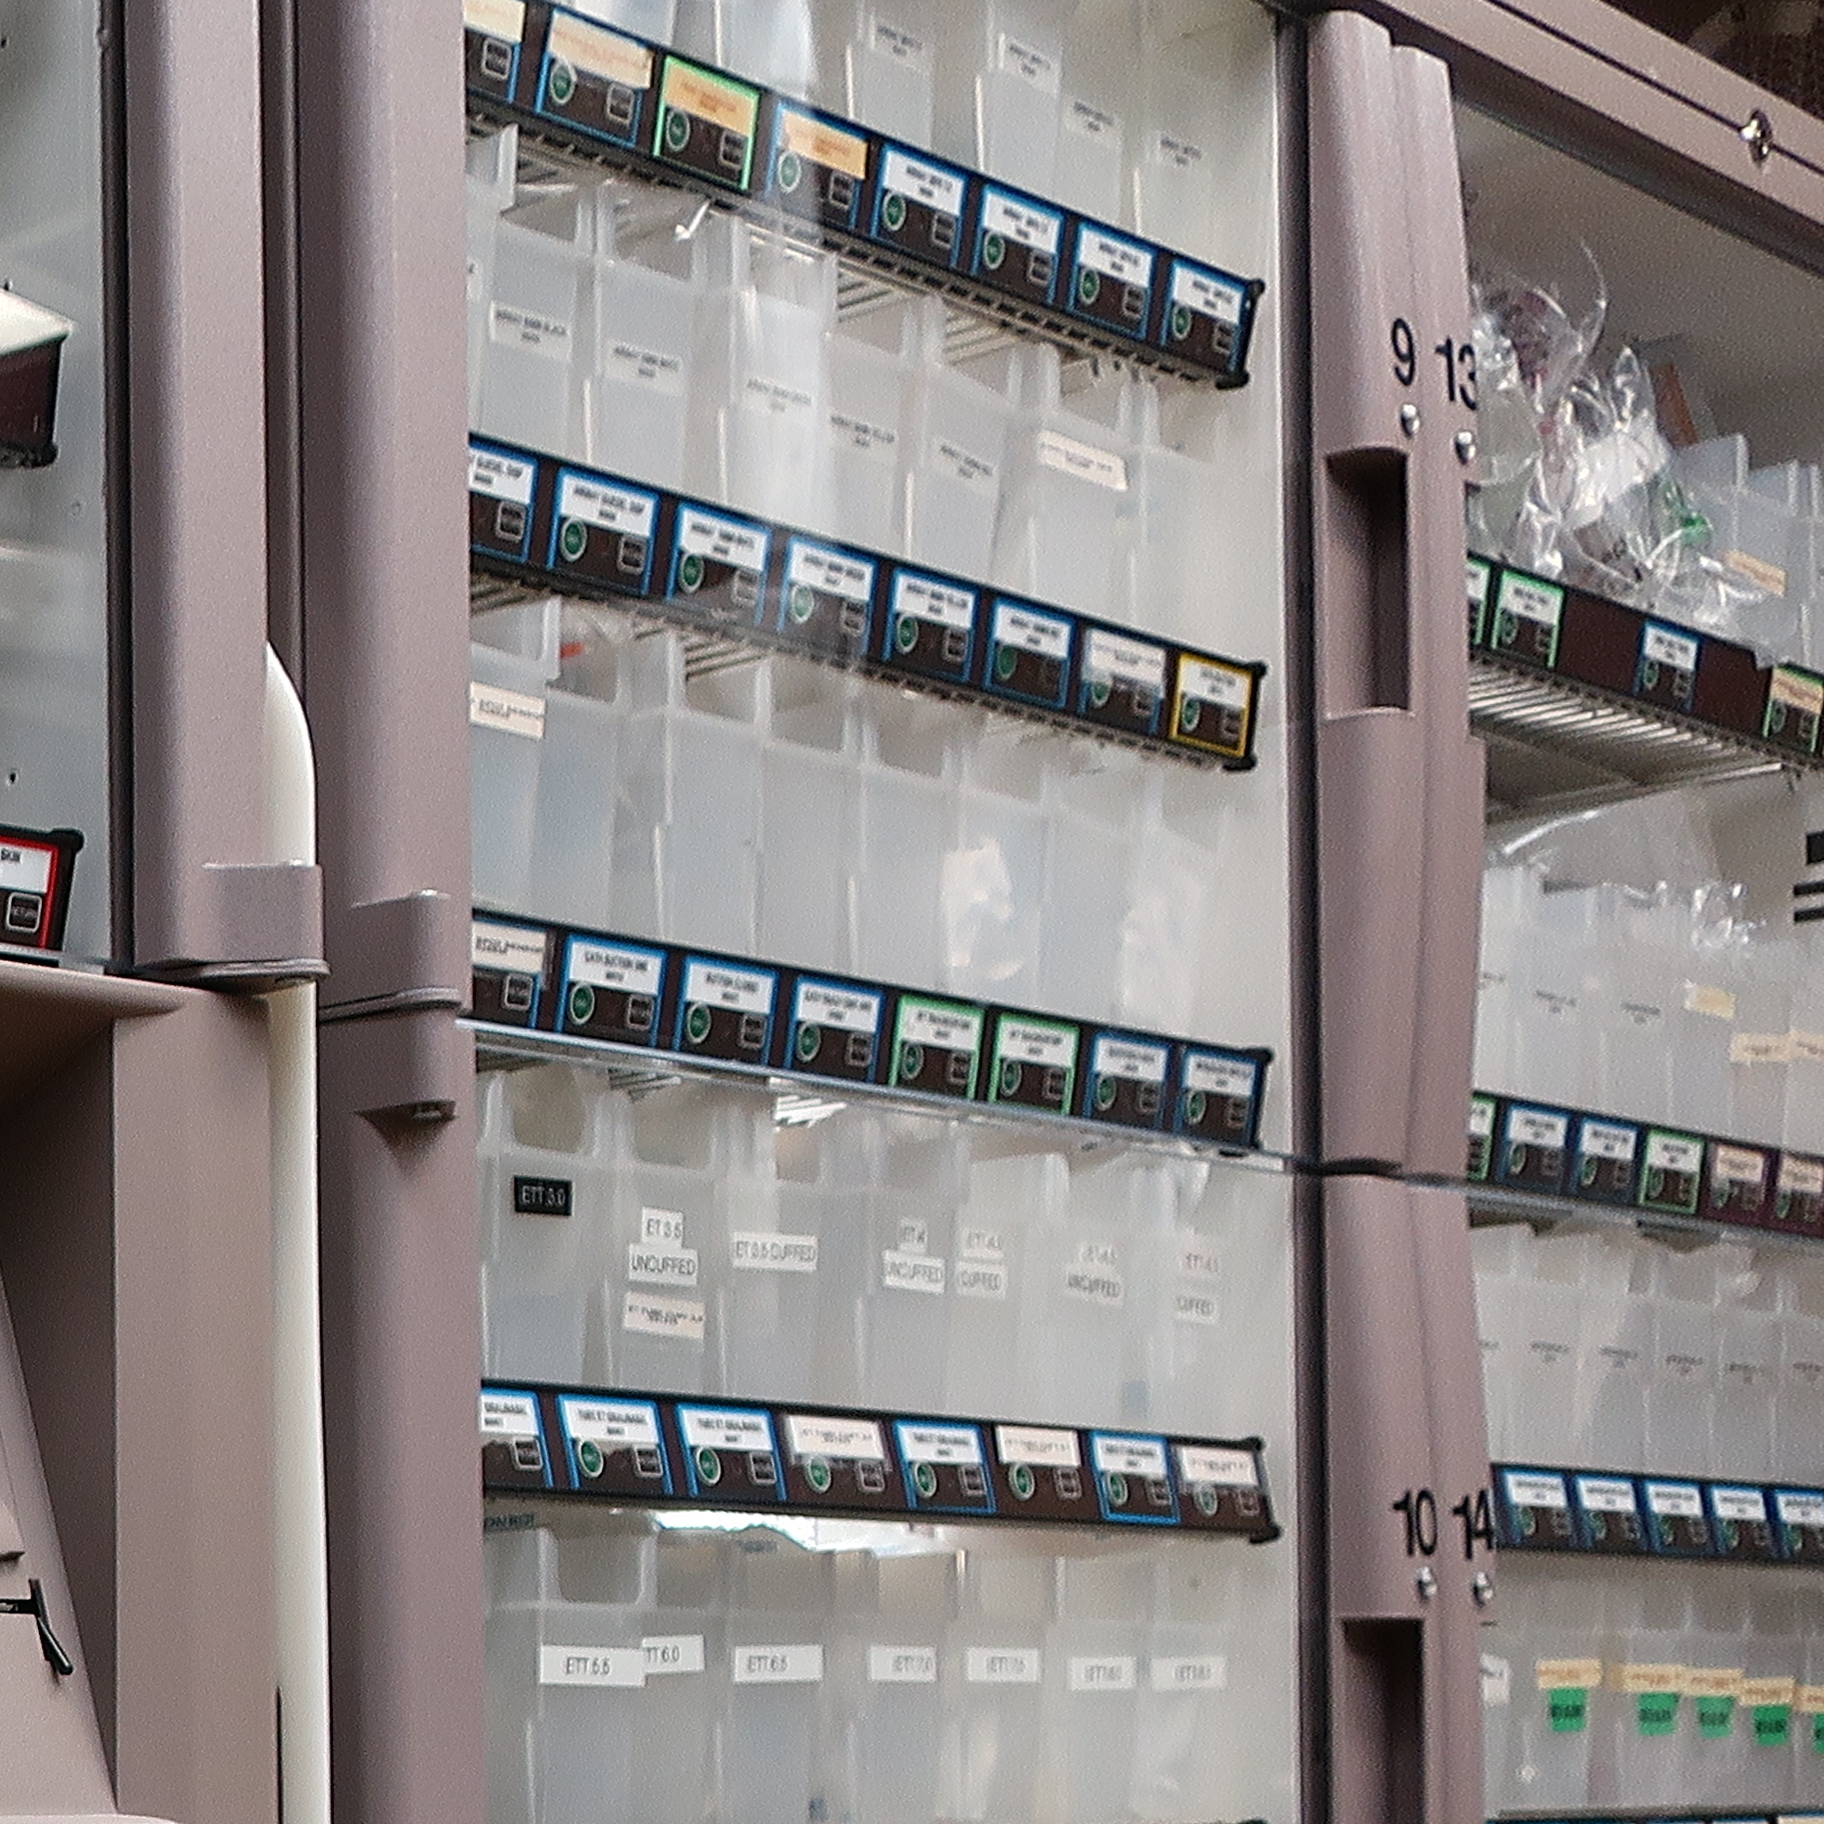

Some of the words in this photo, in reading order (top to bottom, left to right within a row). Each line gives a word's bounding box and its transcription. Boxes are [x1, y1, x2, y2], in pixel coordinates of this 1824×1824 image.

[1392, 318, 1416, 386] 9
[522, 1186, 544, 1204] ETT
[646, 1218, 661, 1236] ET
[736, 1242, 749, 1258] ET
[770, 1244, 816, 1262] CUFFED
[631, 1254, 695, 1276] UNCUFFED
[1393, 1488, 1437, 1557] 10
[1453, 1490, 1494, 1560] 14
[565, 1657, 589, 1675] ETT
[747, 1655, 768, 1673] ETT
